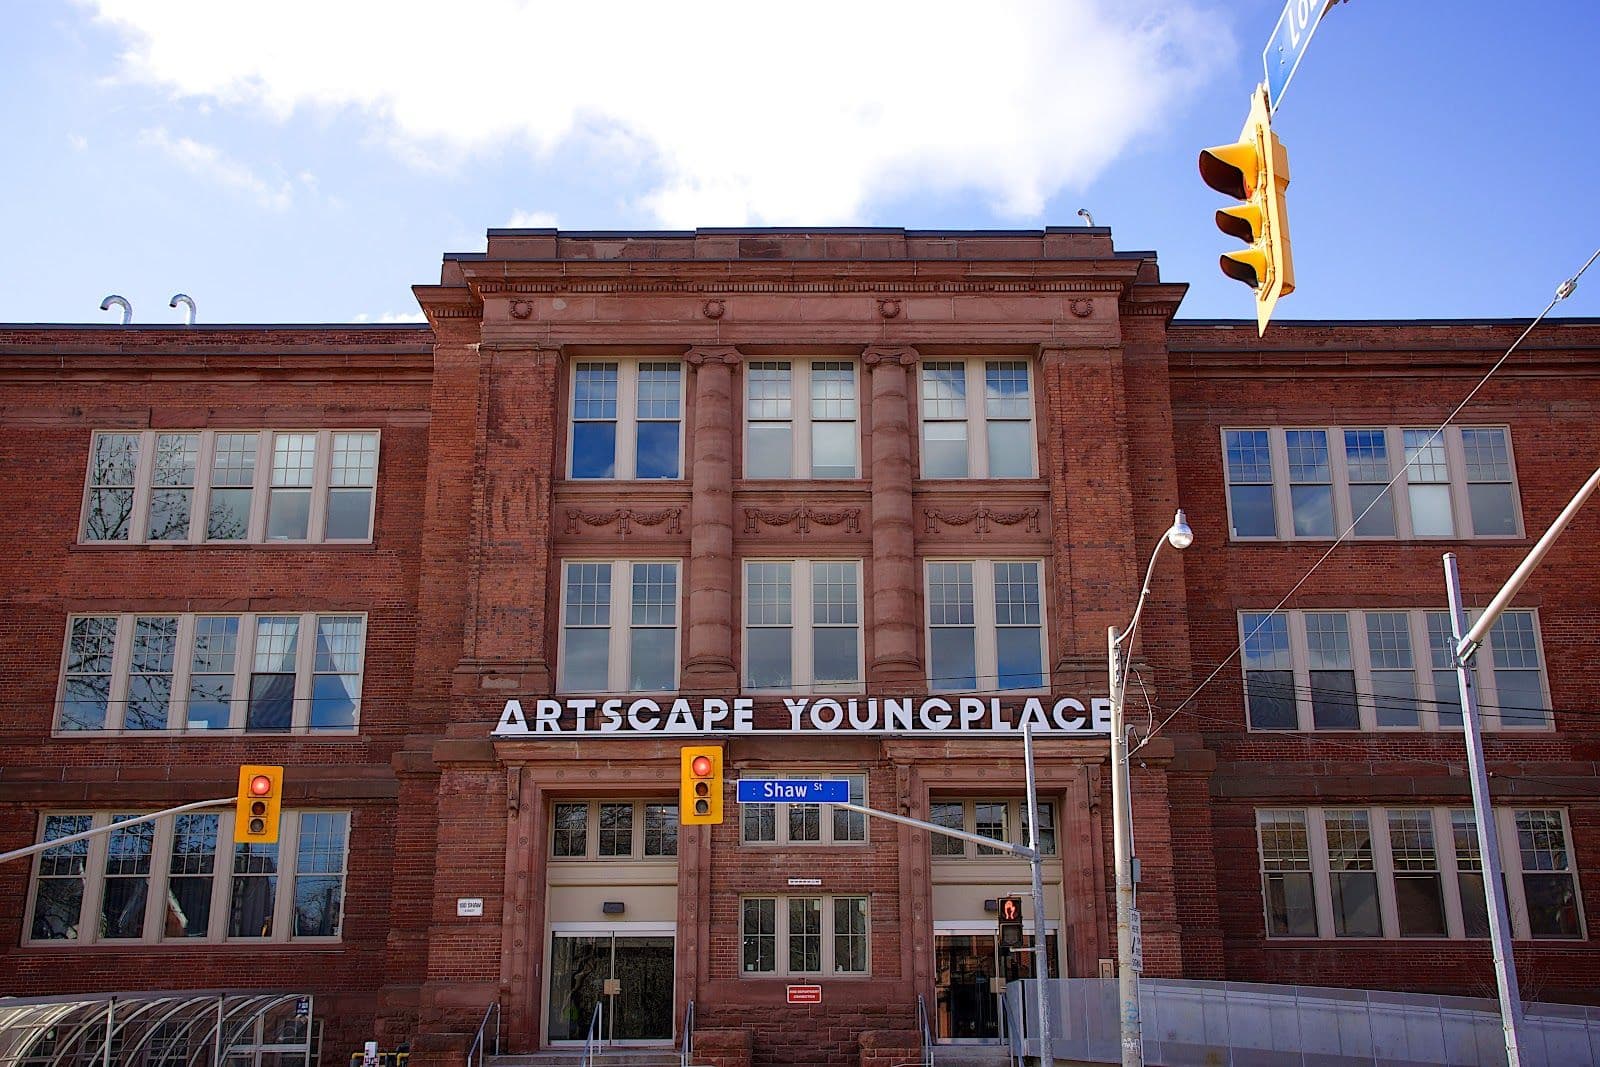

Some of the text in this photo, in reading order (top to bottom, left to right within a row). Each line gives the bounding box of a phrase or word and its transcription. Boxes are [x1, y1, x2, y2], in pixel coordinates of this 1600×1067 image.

[496, 697, 1111, 733] ARTSCAPE YOUNGPLACE
[763, 782, 823, 798] Shaw St
